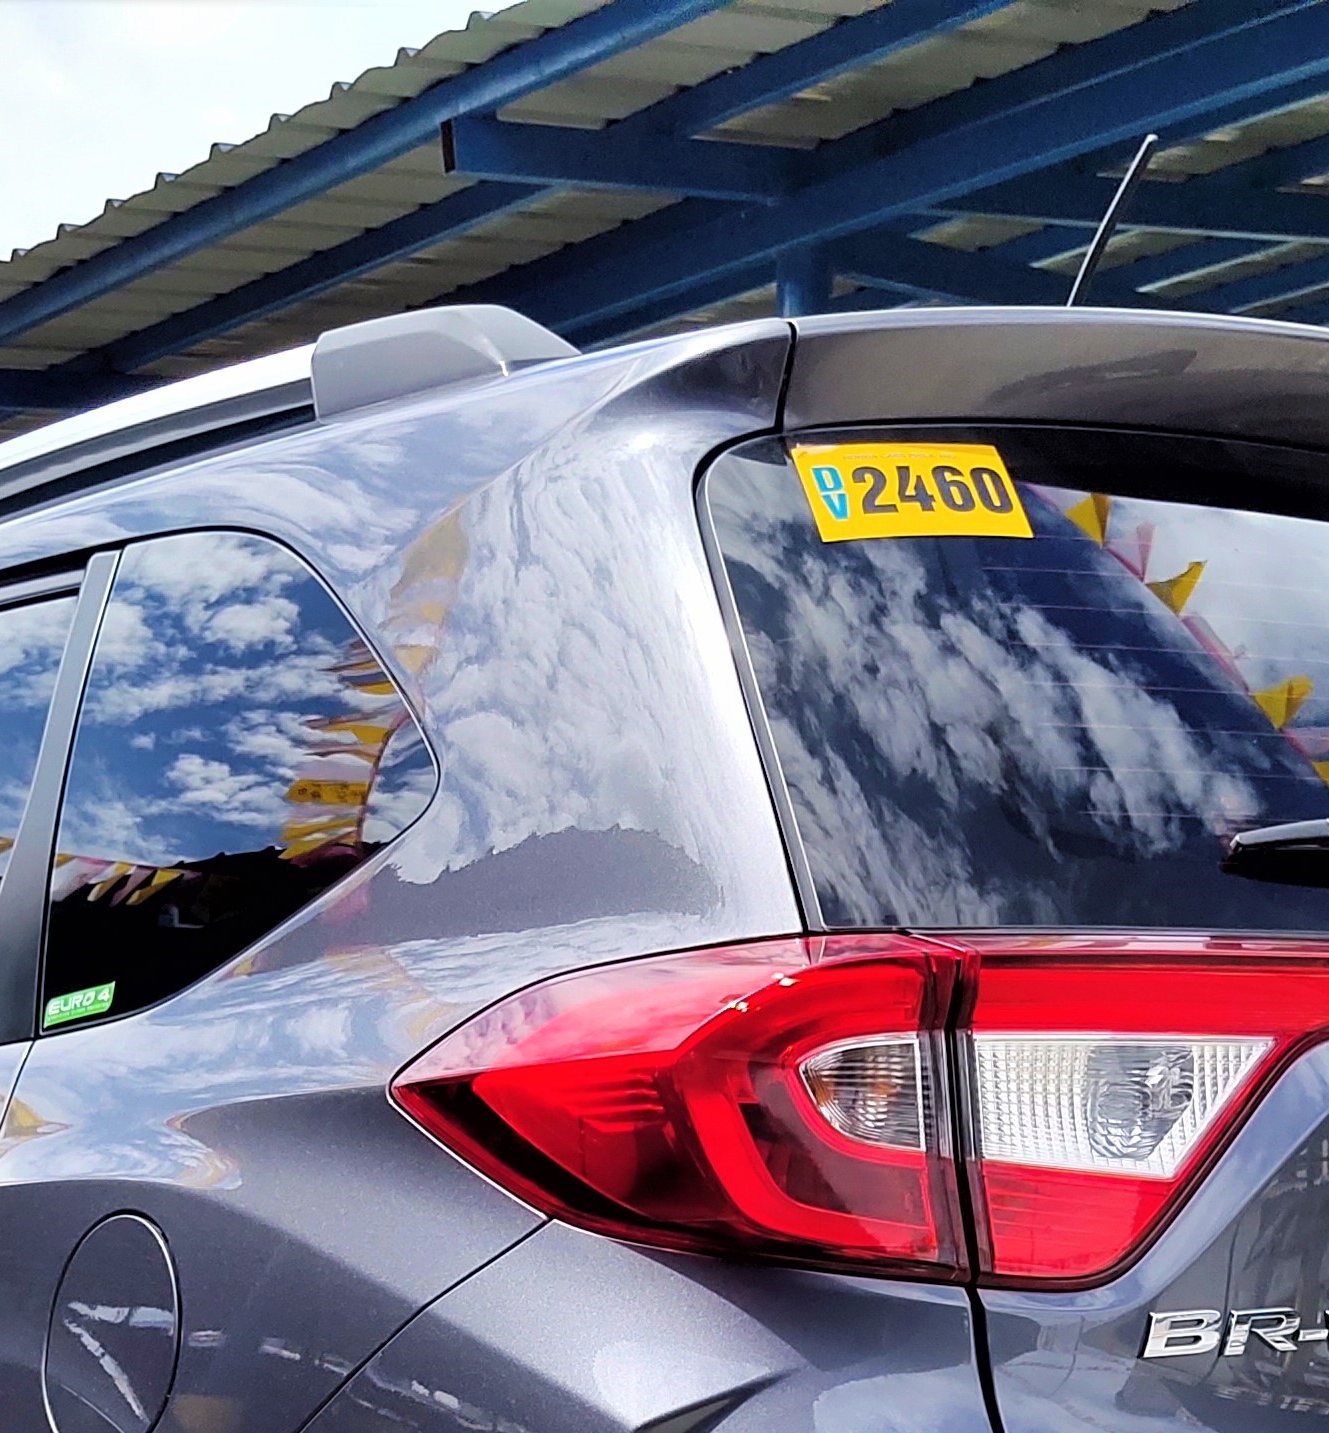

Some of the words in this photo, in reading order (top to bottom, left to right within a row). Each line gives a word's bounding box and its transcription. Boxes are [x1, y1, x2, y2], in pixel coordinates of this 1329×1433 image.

[851, 465, 1014, 515] 2460
[49, 991, 96, 1015] EURO
[97, 988, 111, 1002] 4
